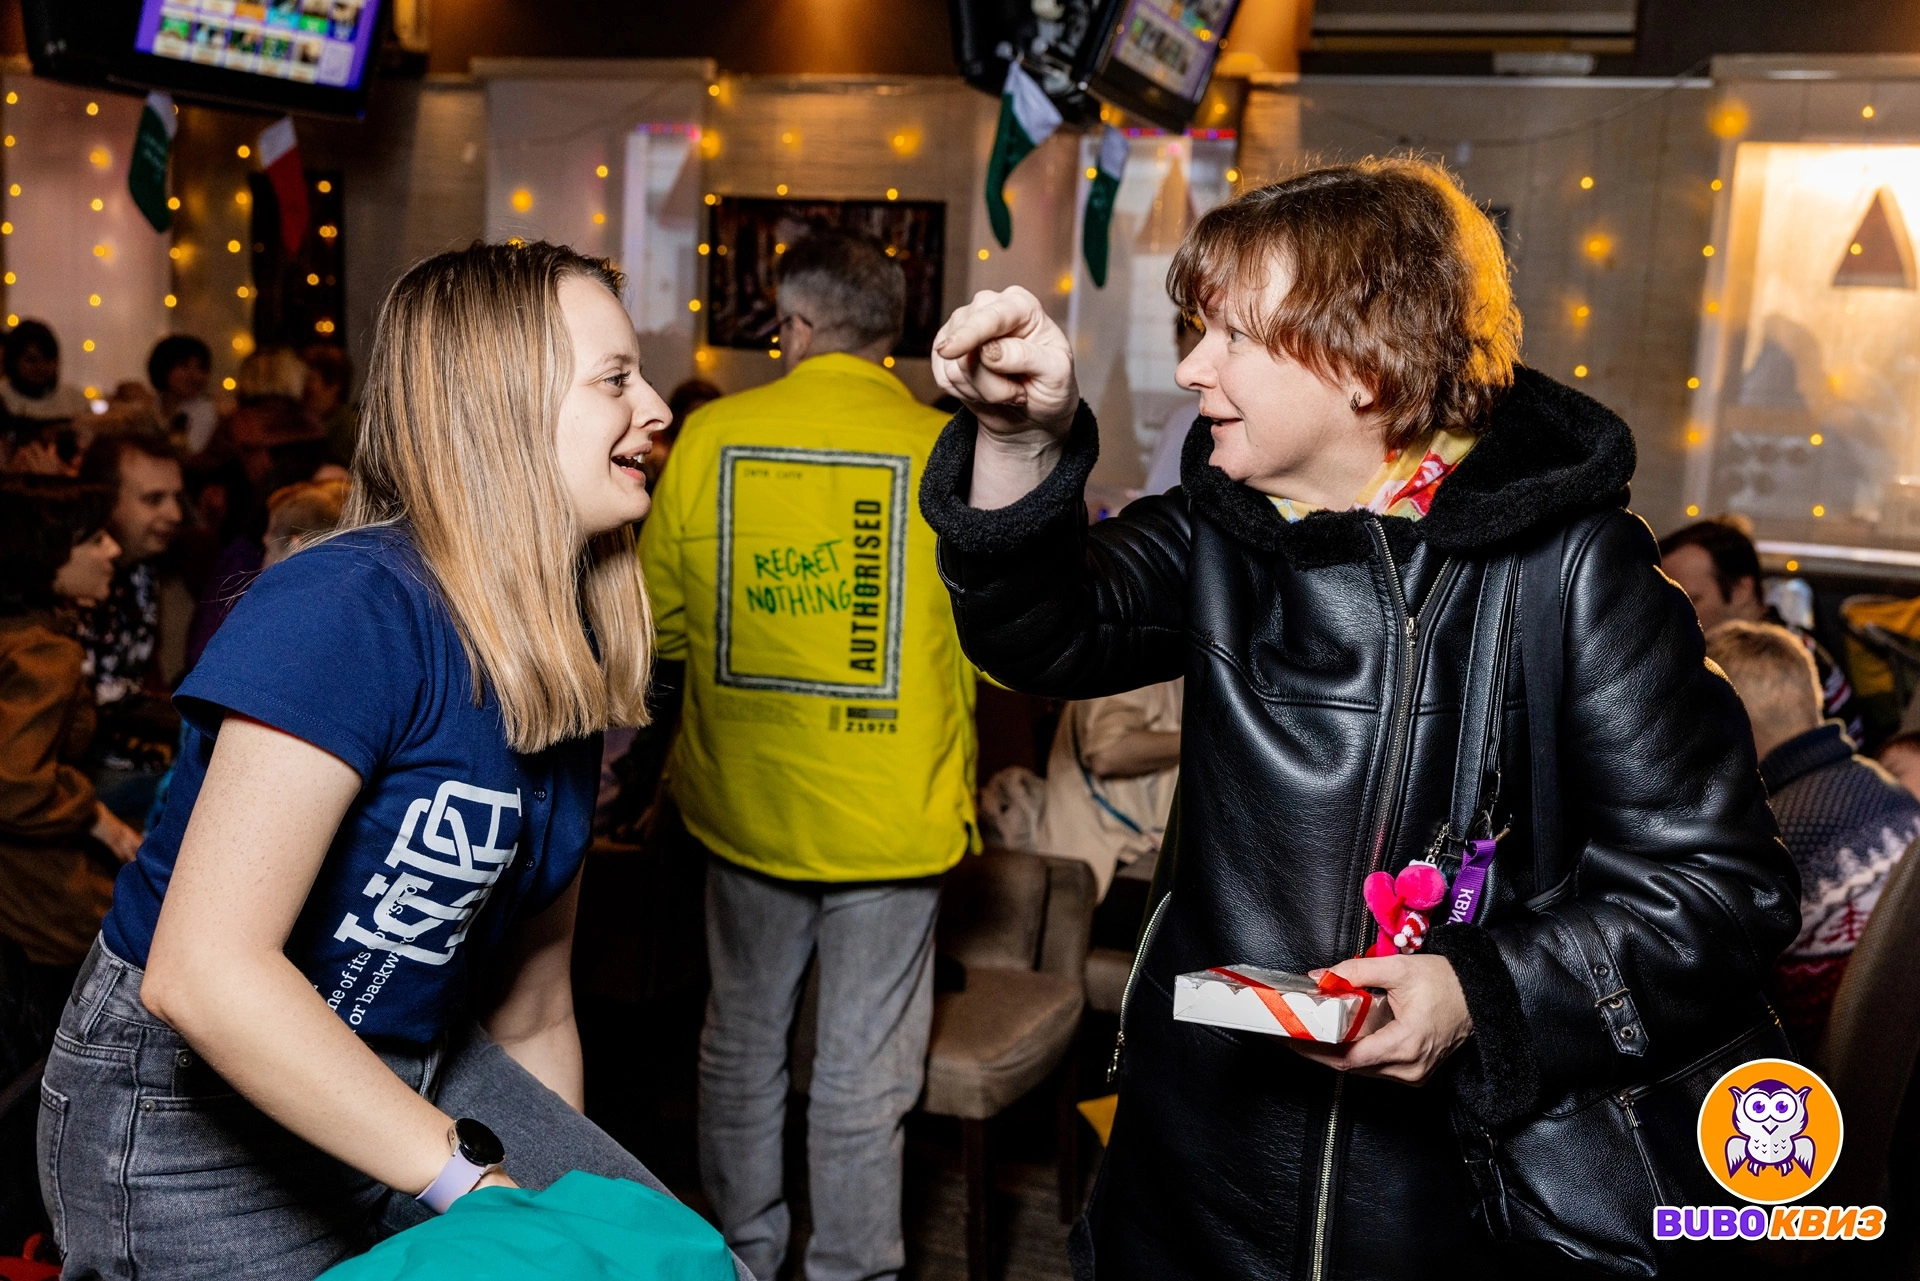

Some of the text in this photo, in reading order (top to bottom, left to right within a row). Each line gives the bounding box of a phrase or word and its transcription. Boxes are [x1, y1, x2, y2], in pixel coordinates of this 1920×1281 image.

[753, 539, 843, 582] REGRET
[849, 499, 882, 673] AUTHORISED
[1446, 888, 1475, 925] КВИ
[347, 951, 372, 973] its
[340, 970, 358, 989] of
[349, 1004, 366, 1025] or
